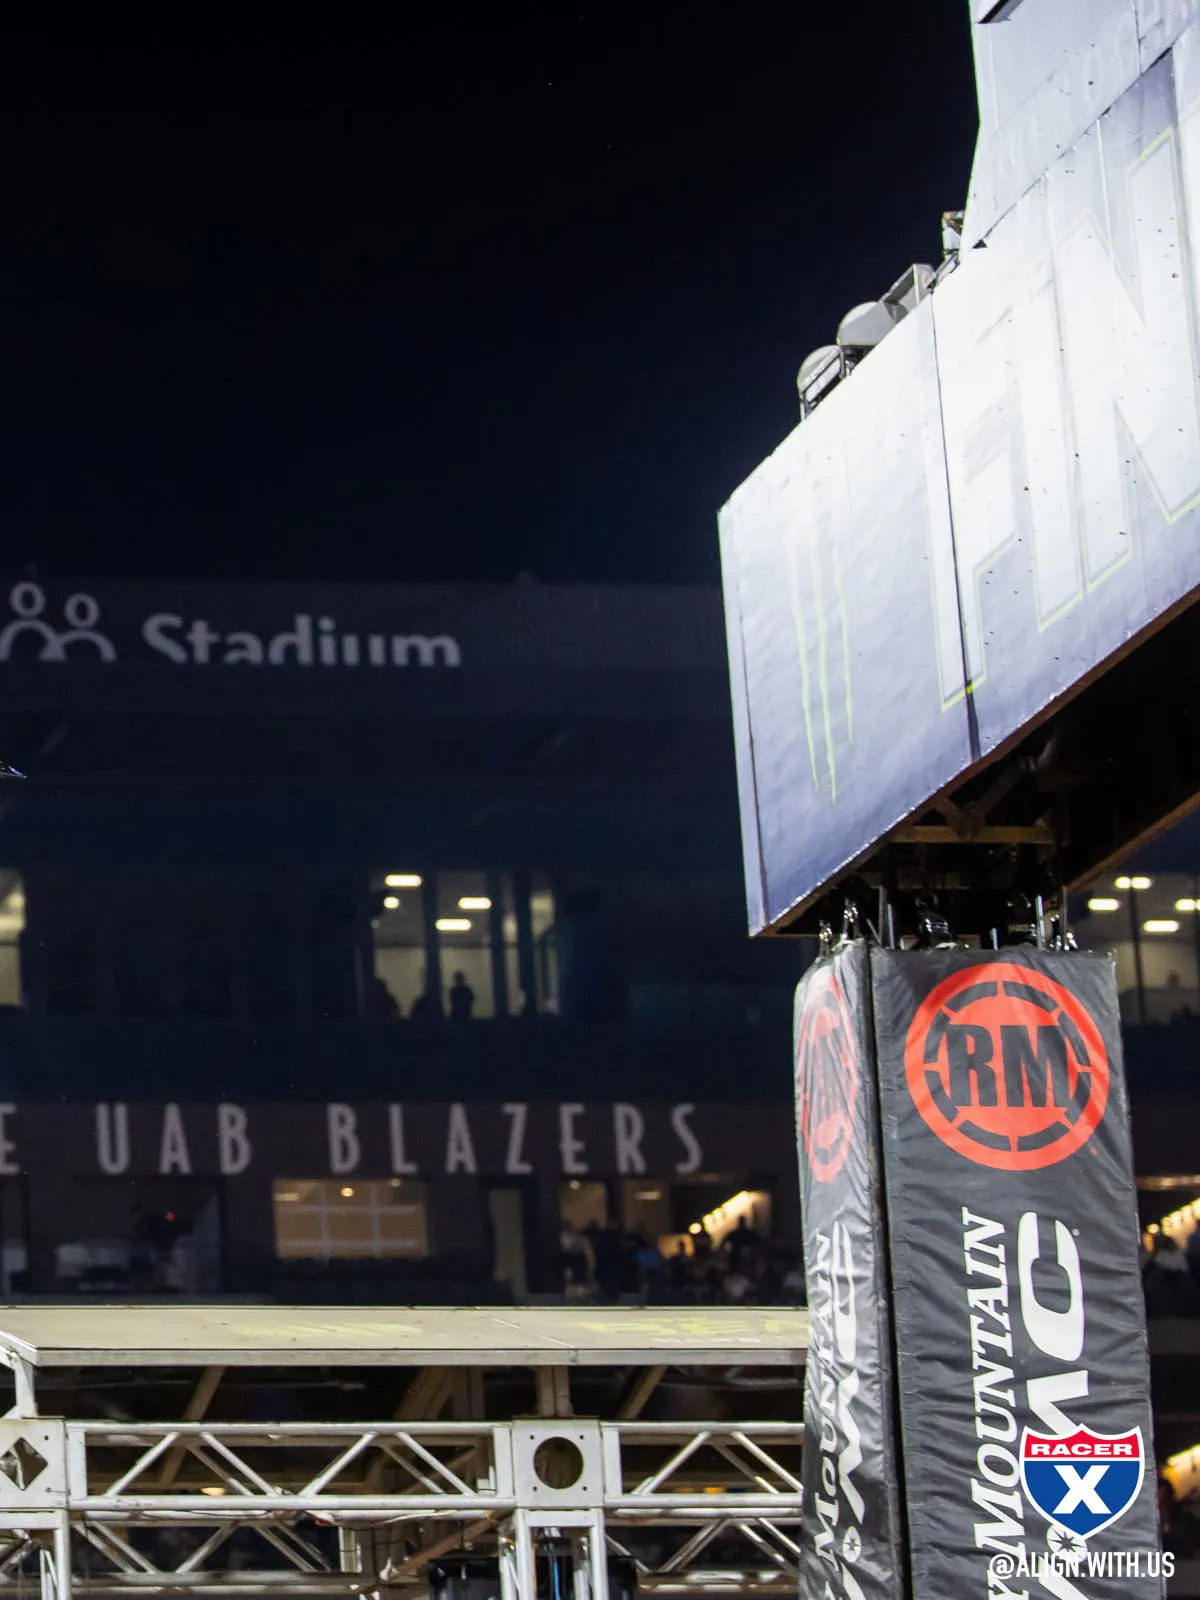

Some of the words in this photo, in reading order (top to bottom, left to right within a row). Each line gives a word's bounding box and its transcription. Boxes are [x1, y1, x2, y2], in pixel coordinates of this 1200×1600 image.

[141, 612, 462, 666] Stadium
[946, 1023, 1072, 1108] RM
[97, 1103, 252, 1174] UAB
[327, 1103, 703, 1174] BLAZERS
[960, 1206, 1030, 1572] MOUNTAIN
